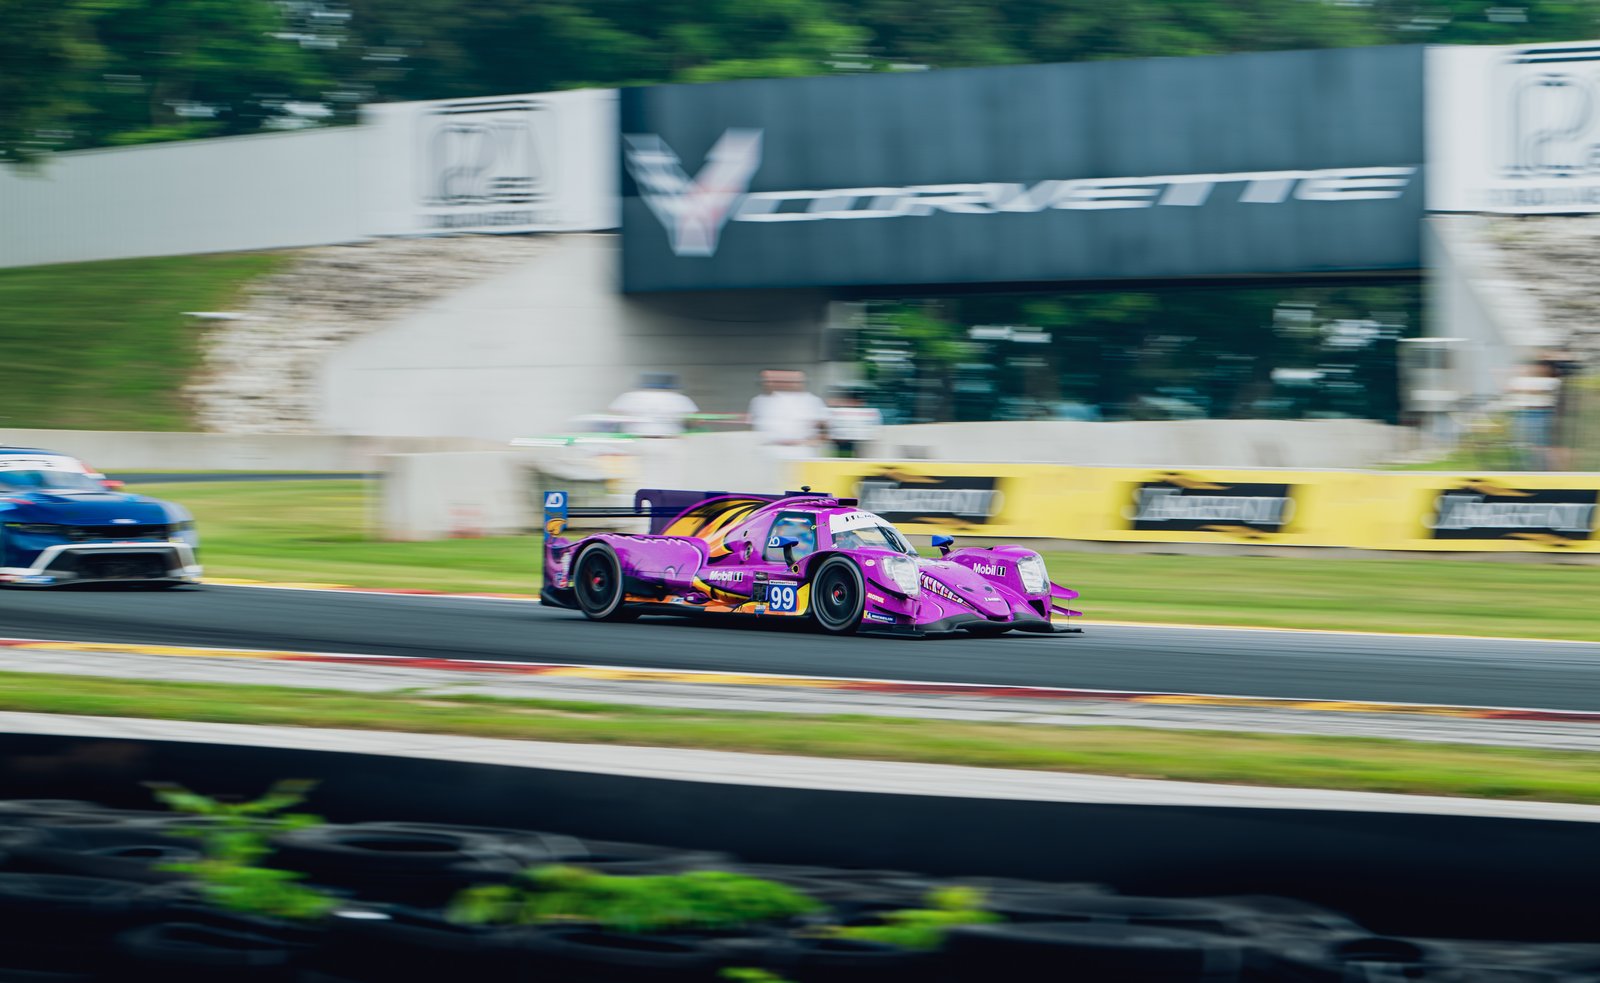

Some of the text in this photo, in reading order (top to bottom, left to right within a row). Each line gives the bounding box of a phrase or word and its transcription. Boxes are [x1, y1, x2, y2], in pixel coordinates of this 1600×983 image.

[731, 166, 1418, 222] CORVETTE
[709, 571, 733, 581] Mobil
[973, 563, 996, 576] Mobil
[771, 586, 795, 610] 99
